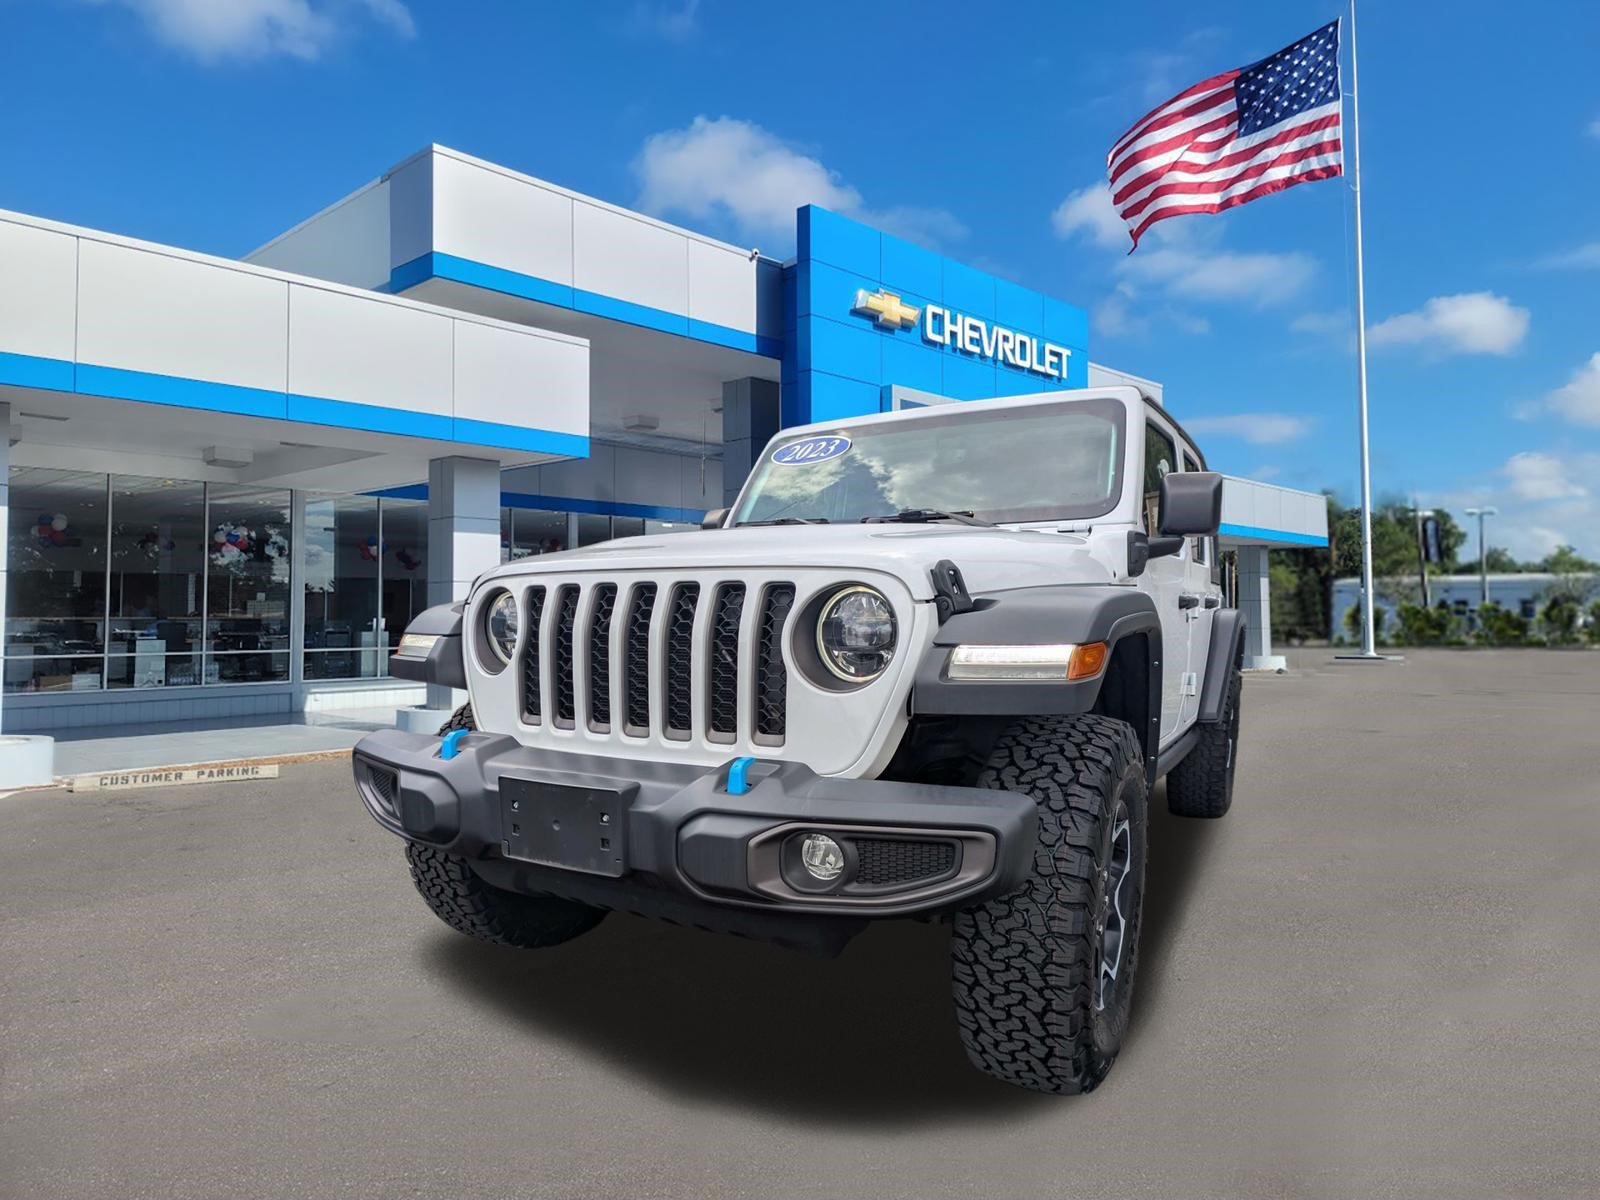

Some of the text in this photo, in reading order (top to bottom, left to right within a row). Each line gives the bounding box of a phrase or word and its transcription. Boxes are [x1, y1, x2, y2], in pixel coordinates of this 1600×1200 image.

[925, 303, 1072, 379] CHEVROLET
[781, 439, 840, 462] 2023
[100, 766, 260, 787] CUSTOMER PARKING
